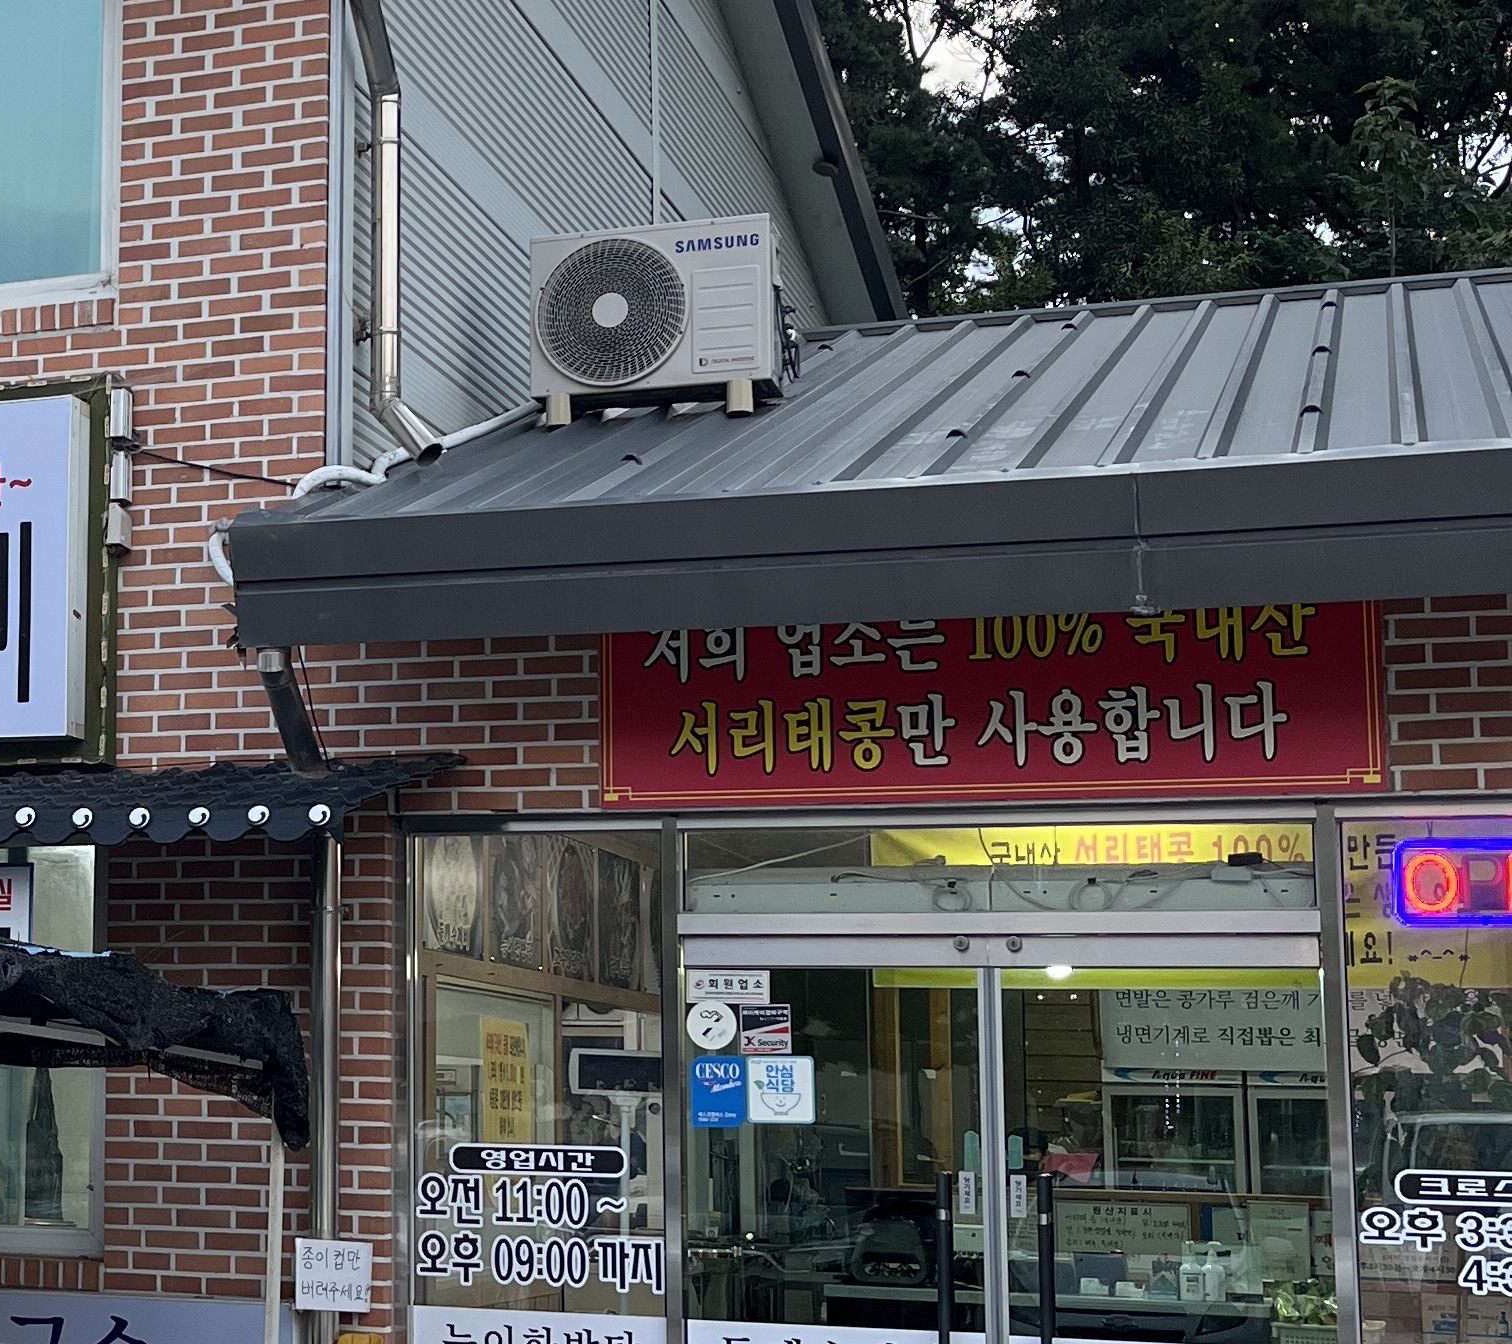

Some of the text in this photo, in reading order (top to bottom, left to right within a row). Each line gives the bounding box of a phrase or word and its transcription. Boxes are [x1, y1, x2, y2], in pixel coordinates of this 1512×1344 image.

[675, 233, 760, 253] SAMSUNG
[643, 627, 748, 684] 저희
[670, 680, 1288, 775] 서리태콩만 사용합니다
[708, 978, 764, 991] 회원업소
[1115, 989, 1173, 1009] 면발은
[1176, 990, 1236, 1010] 콩가루
[1241, 990, 1300, 1010] 검은깨
[758, 1038, 789, 1049] Security
[1116, 1024, 1211, 1046] 냉면기계로
[1217, 1026, 1296, 1047] 직접뽑은
[695, 1062, 740, 1079] CESCO
[765, 1064, 794, 1078] 안심
[1189, 1070, 1218, 1080] FINE
[766, 1079, 795, 1093] 식당
[480, 1149, 595, 1172] 영업시간
[419, 1175, 481, 1225] 오전
[493, 1179, 586, 1226] 11:00
[1363, 1210, 1443, 1249] 오후
[419, 1233, 663, 1291] 오후 09:00 까지
